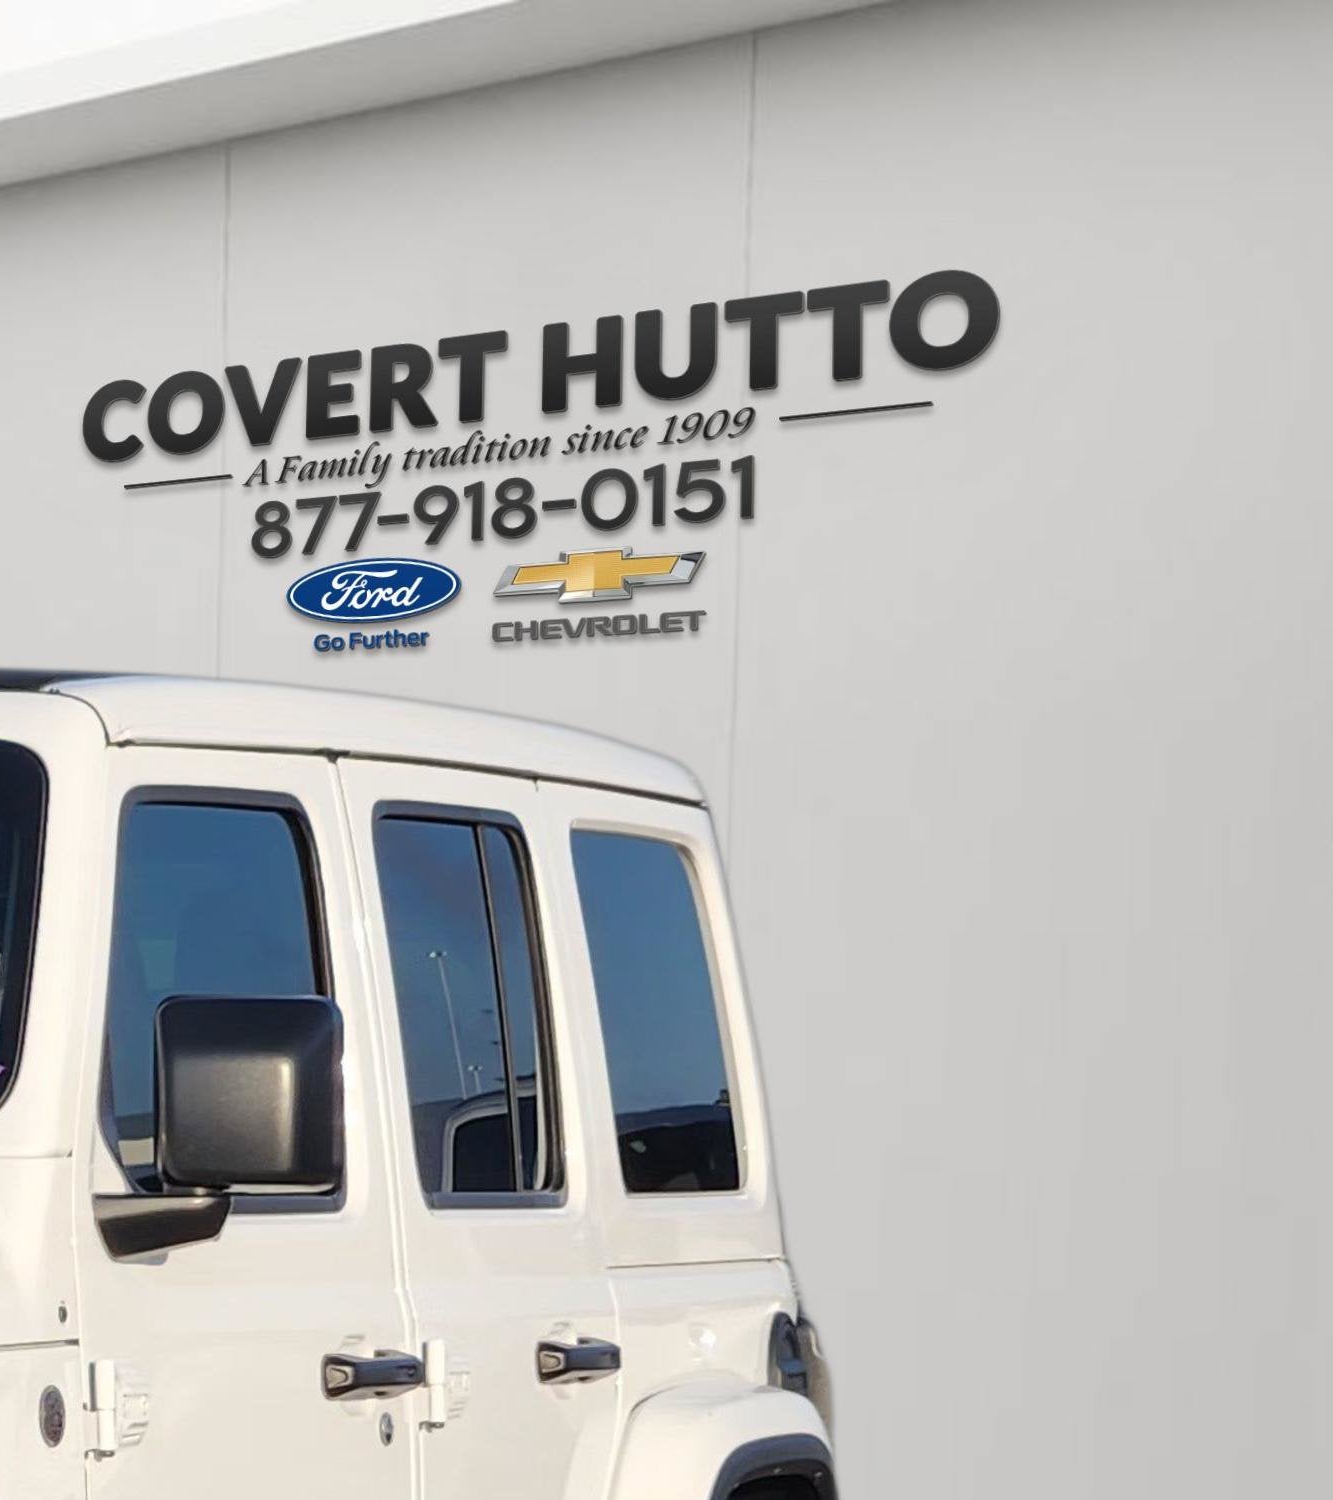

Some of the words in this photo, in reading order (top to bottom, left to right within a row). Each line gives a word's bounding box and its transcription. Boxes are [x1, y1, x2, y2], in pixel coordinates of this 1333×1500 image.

[82, 331, 509, 464] COVERT
[542, 270, 1001, 414] HUTTO
[242, 458, 269, 488] A
[275, 441, 392, 489] Family
[402, 430, 551, 472] tradition
[561, 424, 649, 456] since
[657, 406, 756, 446] 1909
[251, 456, 755, 560] 877-918-0151
[320, 569, 424, 611] Ford
[313, 633, 346, 653] Go
[348, 629, 430, 651] Further
[491, 610, 707, 644] CHEVROLET
